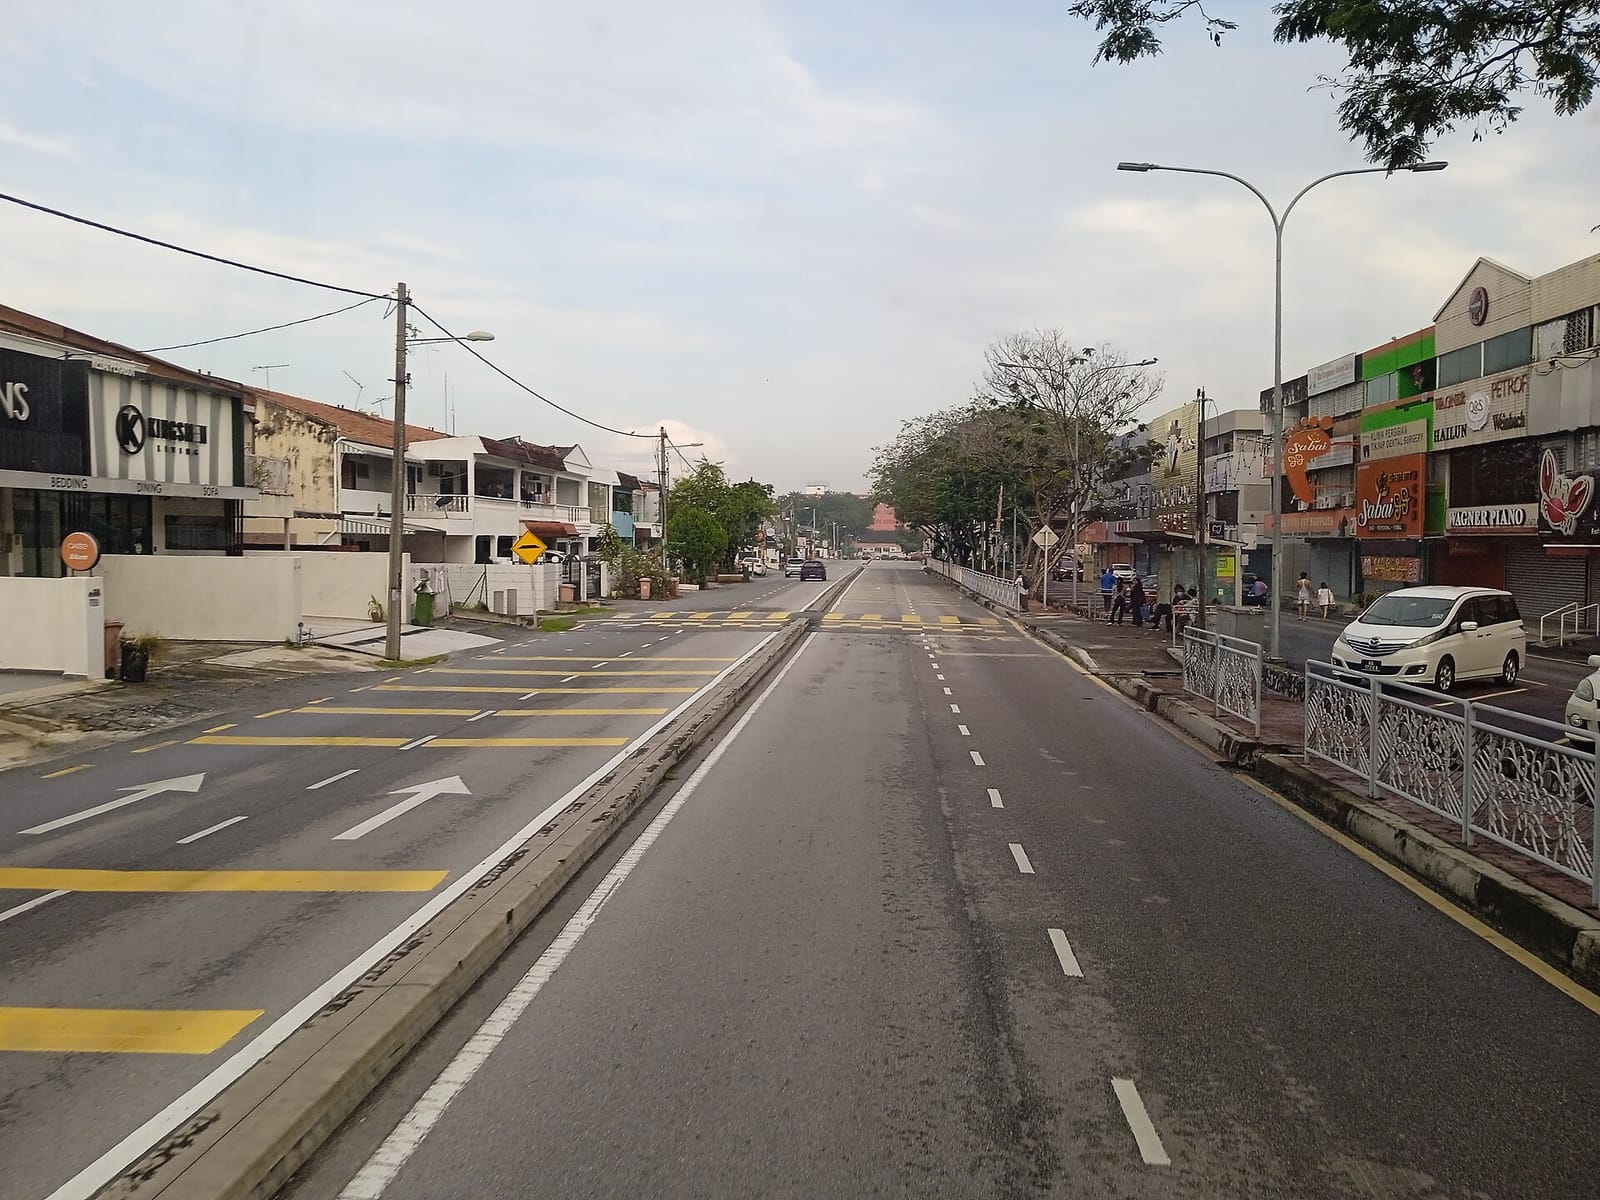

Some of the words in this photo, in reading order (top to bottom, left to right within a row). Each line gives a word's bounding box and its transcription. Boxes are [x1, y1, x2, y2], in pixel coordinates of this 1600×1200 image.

[148, 417, 207, 444] KINGSMEN
[1433, 424, 1467, 443] HAILUN
[1386, 437, 1404, 448] DENTAL
[1403, 432, 1424, 445] SURGERY
[157, 445, 199, 456] LIVING
[51, 476, 88, 489] BEDDING
[137, 482, 162, 494] DINING
[203, 486, 219, 496] SOFA
[1450, 510, 1489, 527] WAGNER
[1489, 507, 1525, 526] PIANO
